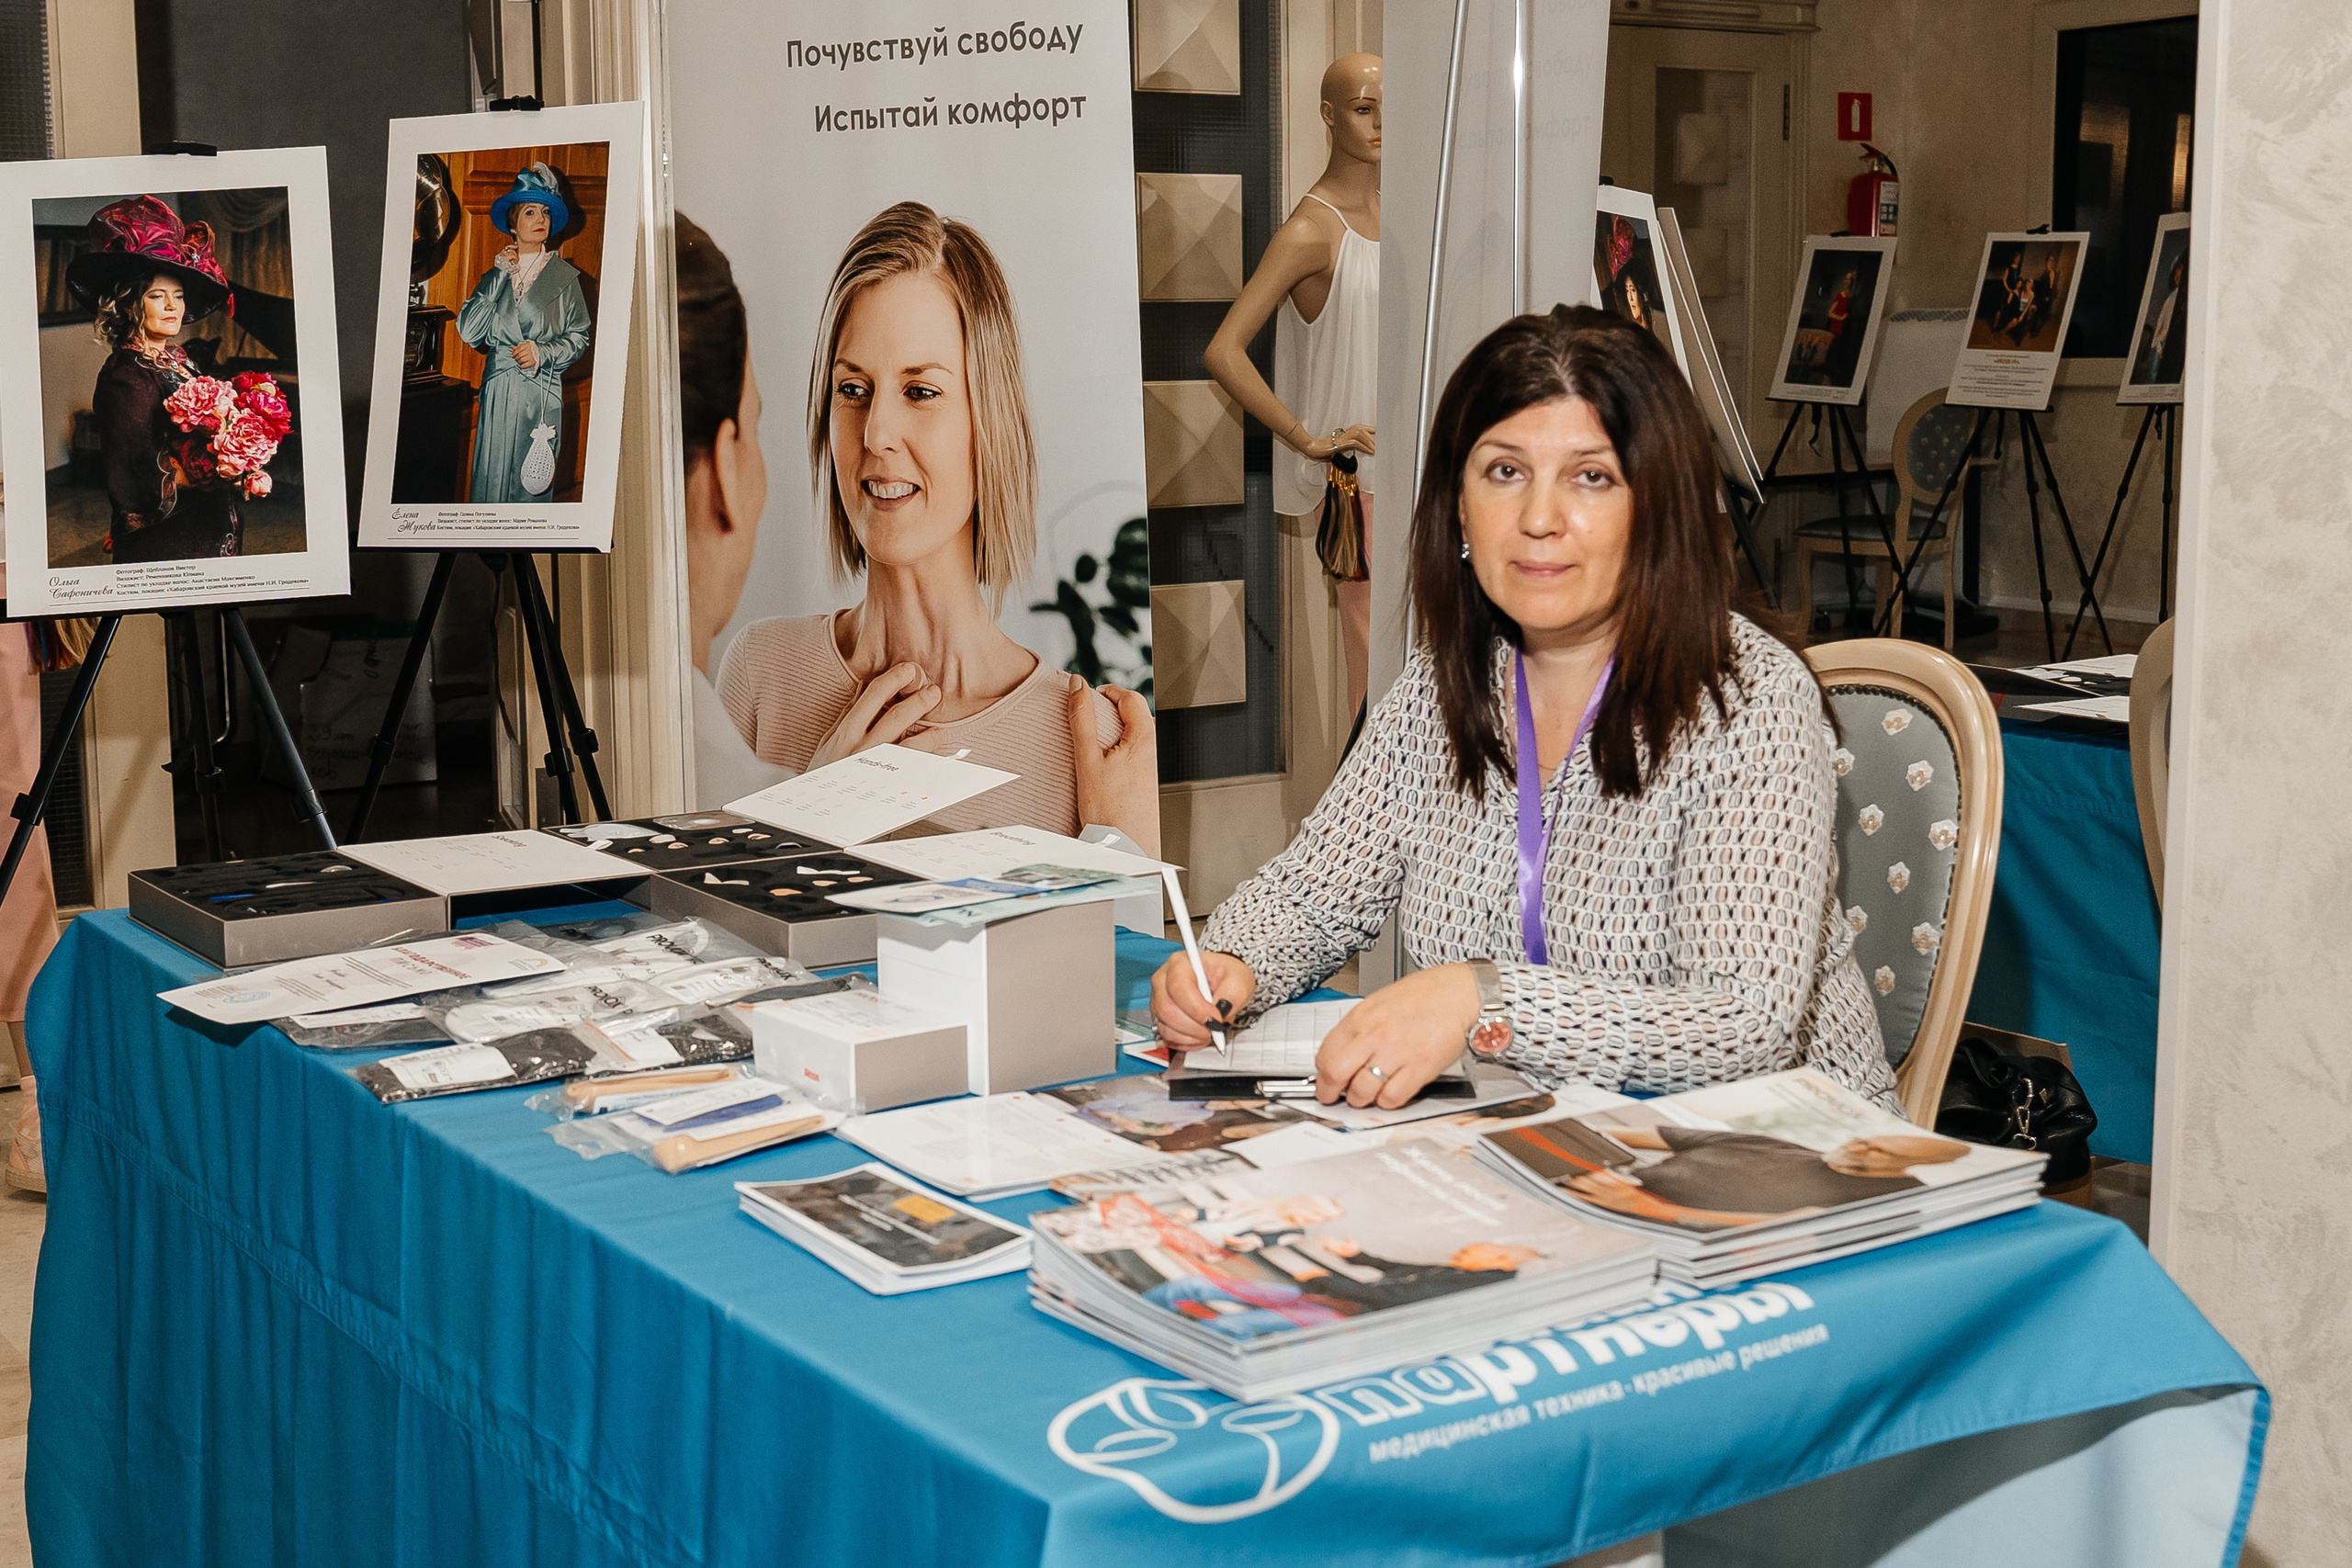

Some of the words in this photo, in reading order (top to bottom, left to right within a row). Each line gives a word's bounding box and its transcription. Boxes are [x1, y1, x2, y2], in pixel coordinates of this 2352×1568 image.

[786, 26, 949, 72] Почувствуй
[957, 20, 1084, 55] свободу
[814, 96, 939, 132] Испытай
[948, 93, 1087, 130] комфорт
[391, 507, 420, 520] Елена
[397, 519, 436, 535] Жукова
[48, 576, 80, 587] Ольга
[854, 756, 900, 773] Hands-free
[1368, 1403, 1532, 1464] медицинская
[1532, 1379, 1625, 1421] техника
[1632, 1349, 1737, 1398] красивые
[1737, 1323, 1830, 1371] решения
